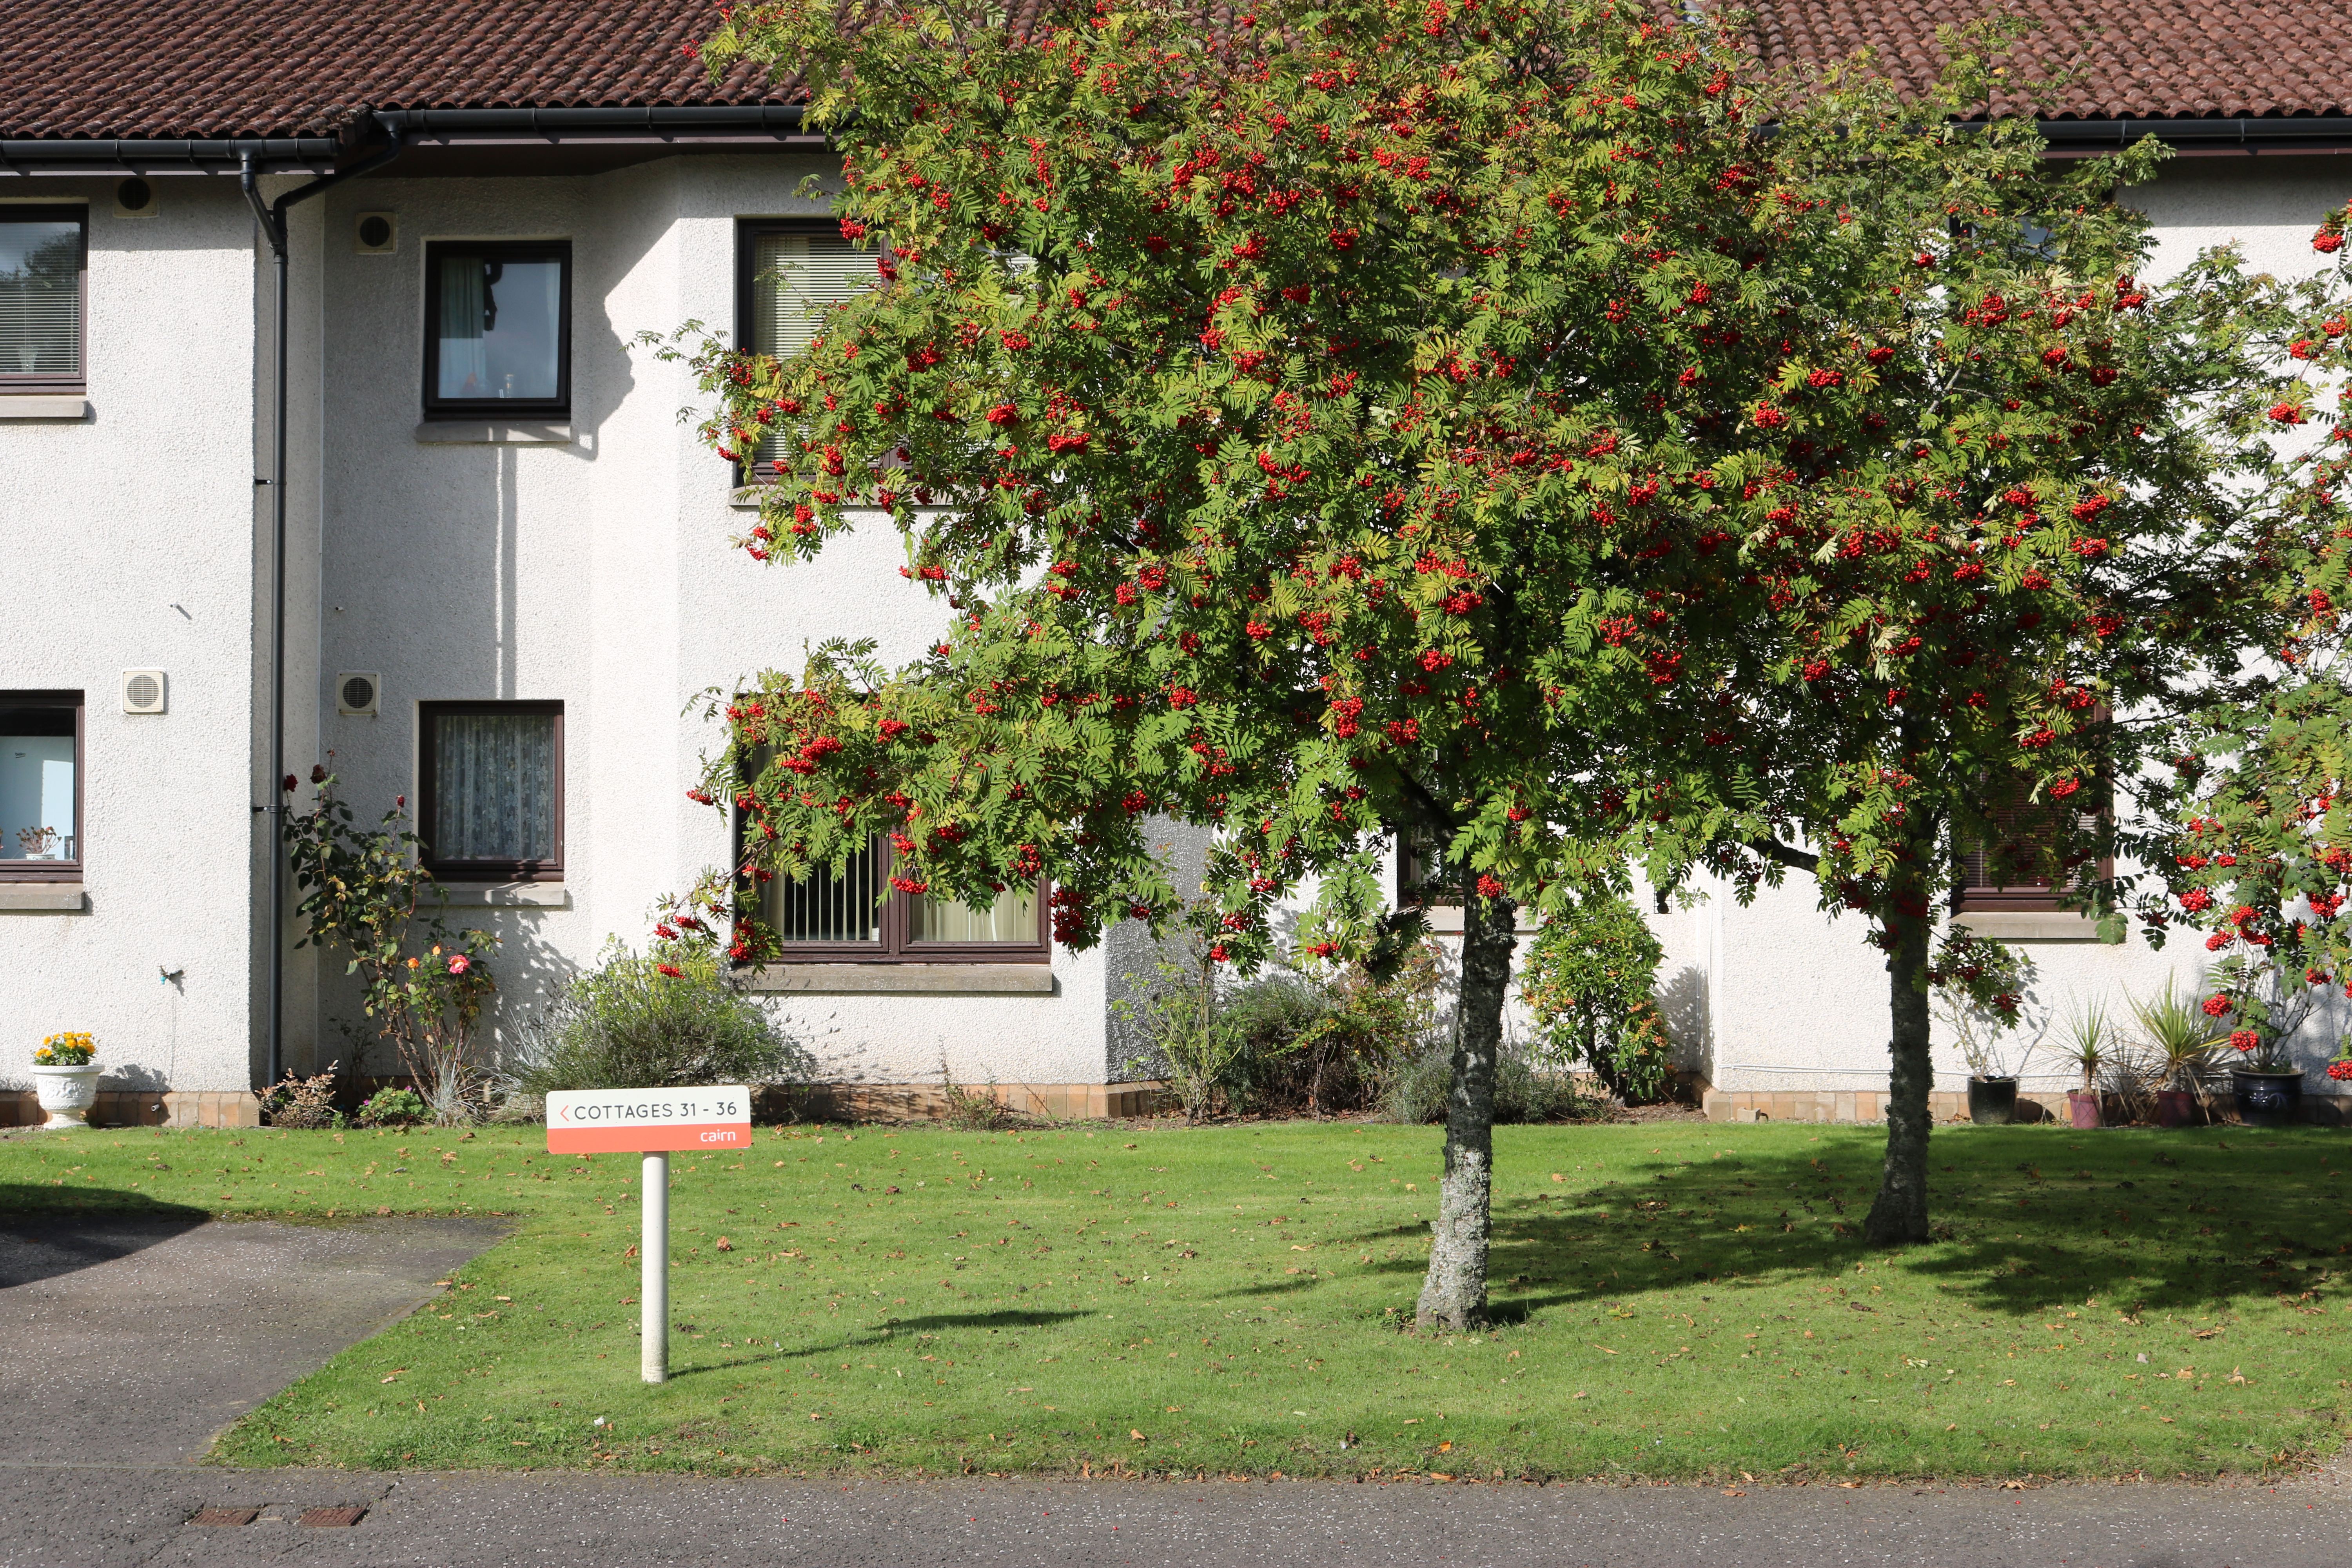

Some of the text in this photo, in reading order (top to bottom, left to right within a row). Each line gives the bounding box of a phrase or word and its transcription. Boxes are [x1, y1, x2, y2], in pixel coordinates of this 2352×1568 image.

[574, 1103, 673, 1120] COTTAGES
[680, 1103, 695, 1117] 31
[716, 1102, 737, 1116] 36
[700, 1129, 736, 1142] cairn
